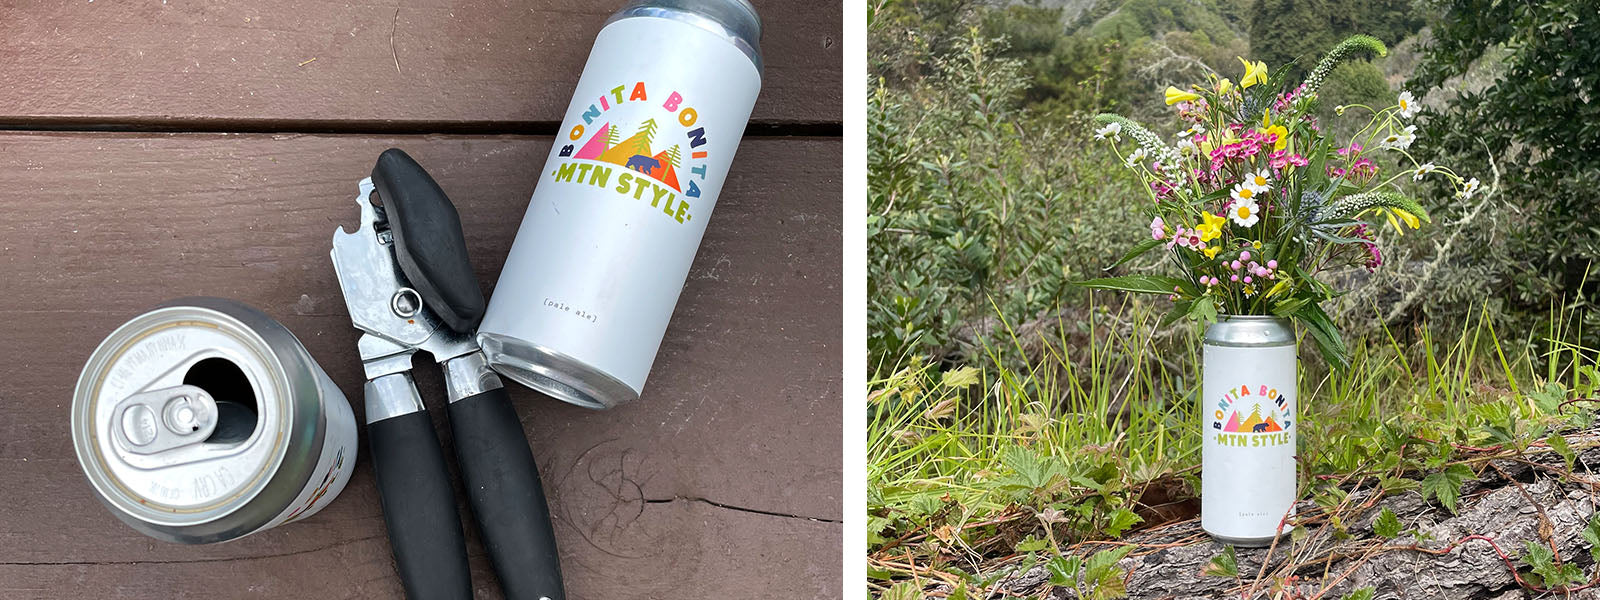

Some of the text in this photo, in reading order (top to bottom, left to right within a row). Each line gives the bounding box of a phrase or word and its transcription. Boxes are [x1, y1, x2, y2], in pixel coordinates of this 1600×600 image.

[558, 81, 708, 199] BONITA BONITA
[554, 162, 690, 225] MTN STYLE
[1213, 384, 1291, 430] BONITA BONITA
[1217, 432, 1289, 447] MTN STYLE
